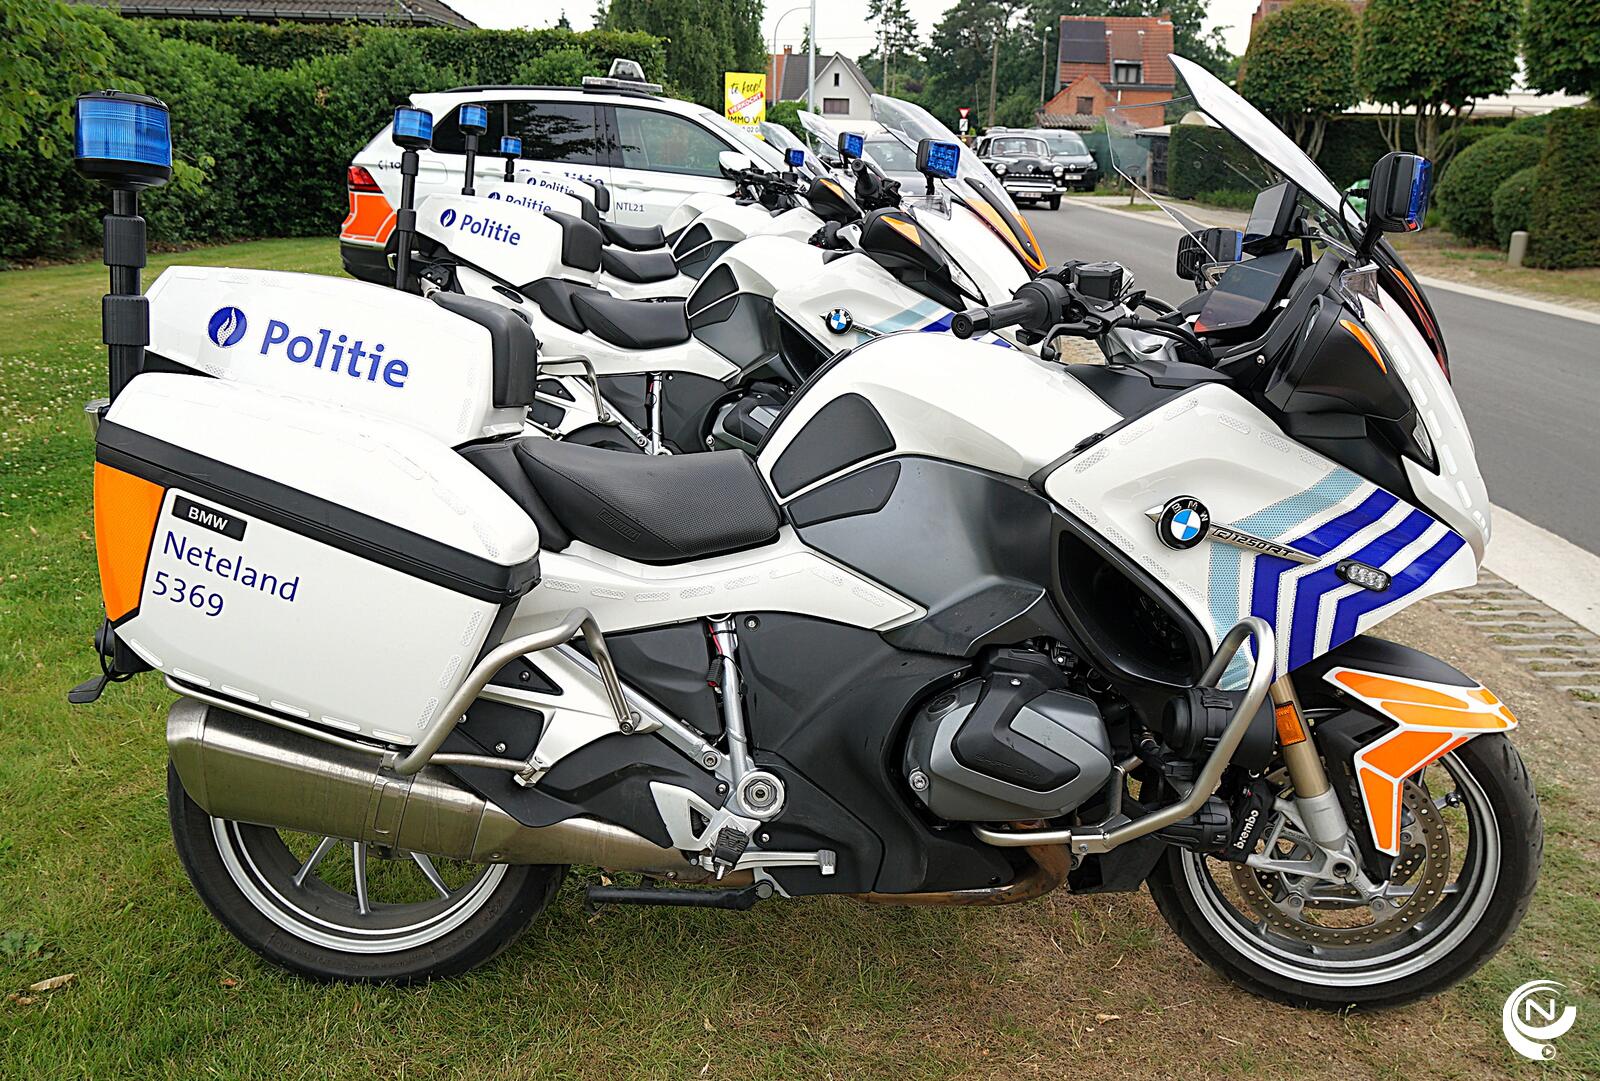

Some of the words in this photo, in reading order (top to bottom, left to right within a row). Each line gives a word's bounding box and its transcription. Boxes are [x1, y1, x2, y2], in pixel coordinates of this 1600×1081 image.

[615, 202, 645, 212] NTL21
[459, 214, 521, 246] Politie
[260, 319, 409, 388] Politie
[187, 505, 229, 532] BMW
[1171, 500, 1209, 522] BMW
[163, 530, 300, 602] Neteland
[152, 570, 224, 617] 5369
[1233, 809, 1260, 850] brembo
